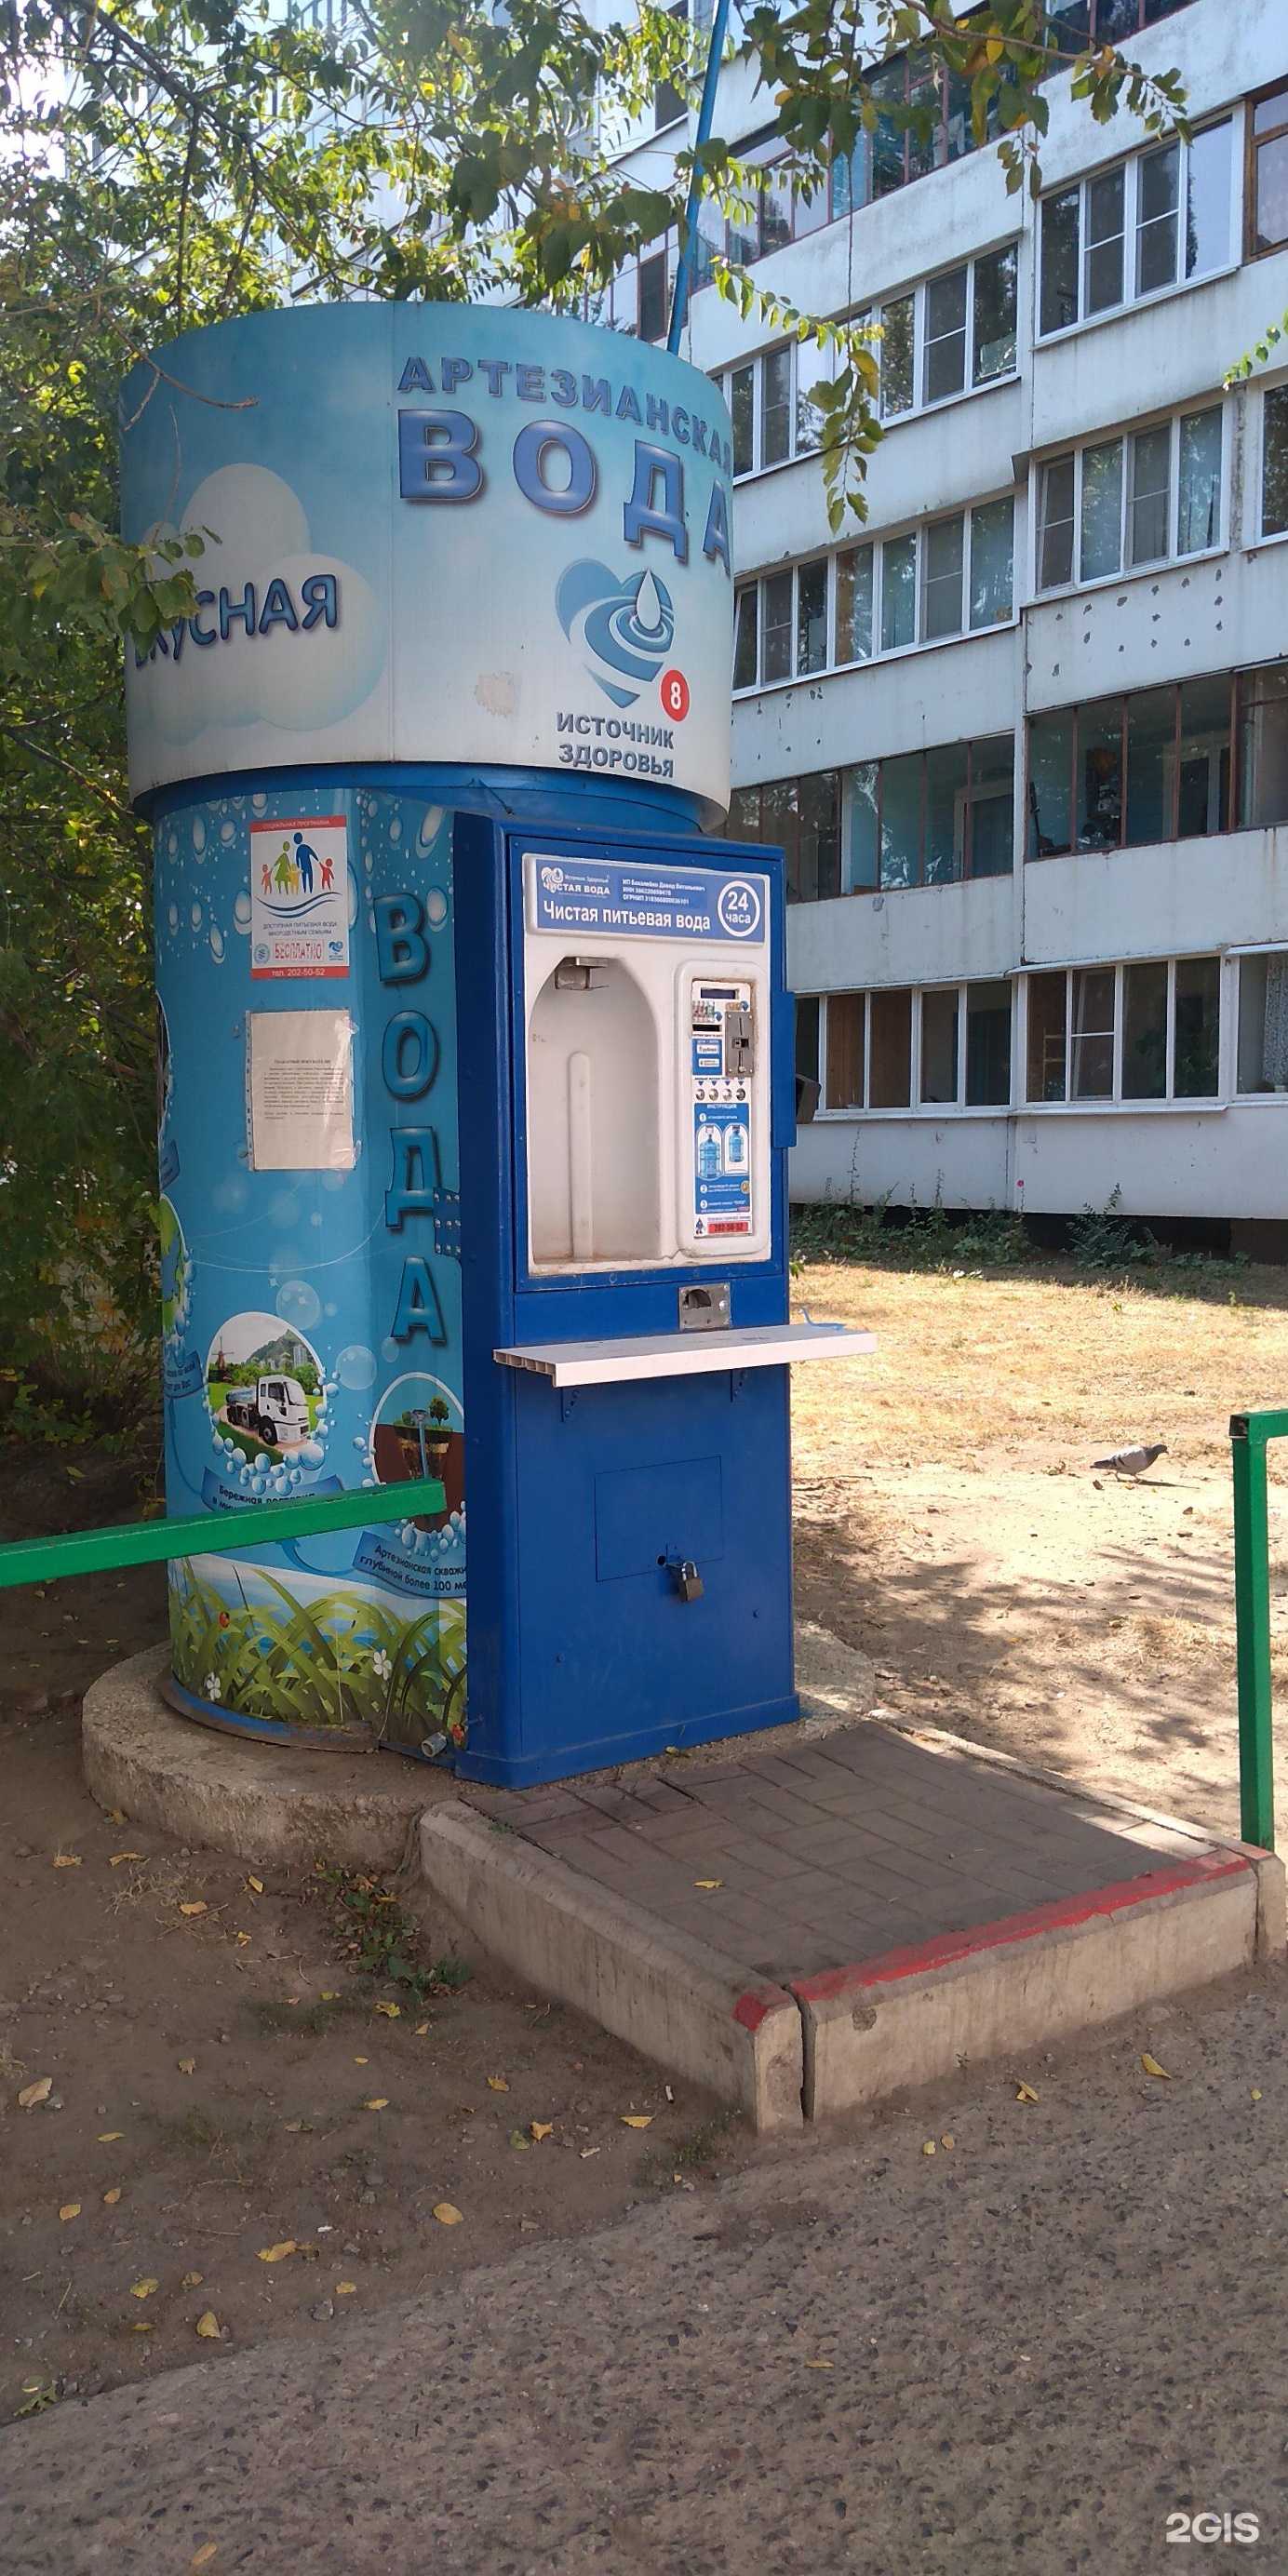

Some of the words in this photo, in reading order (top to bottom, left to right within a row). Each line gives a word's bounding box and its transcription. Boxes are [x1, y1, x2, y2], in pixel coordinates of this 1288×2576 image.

[397, 409, 731, 580] ВОДА
[670, 681, 682, 711] 8
[557, 712, 674, 750] ИСТОЧНИК
[558, 744, 674, 778] ЗДОРОВЬЯ
[584, 884, 610, 894] ВОДА
[728, 892, 749, 911] 24
[543, 900, 598, 922] Чистая
[603, 908, 672, 928] питьевая
[677, 914, 710, 932] вода
[726, 914, 751, 924] часа
[275, 942, 322, 959] БЕСПЛАТНО
[374, 892, 447, 1344] ВОДА
[219, 1484, 262, 1504] Бережная
[360, 1556, 403, 1579] глубиной
[405, 1575, 430, 1590] более
[434, 1581, 452, 1591] 100
[374, 1545, 432, 1574] Артезианская
